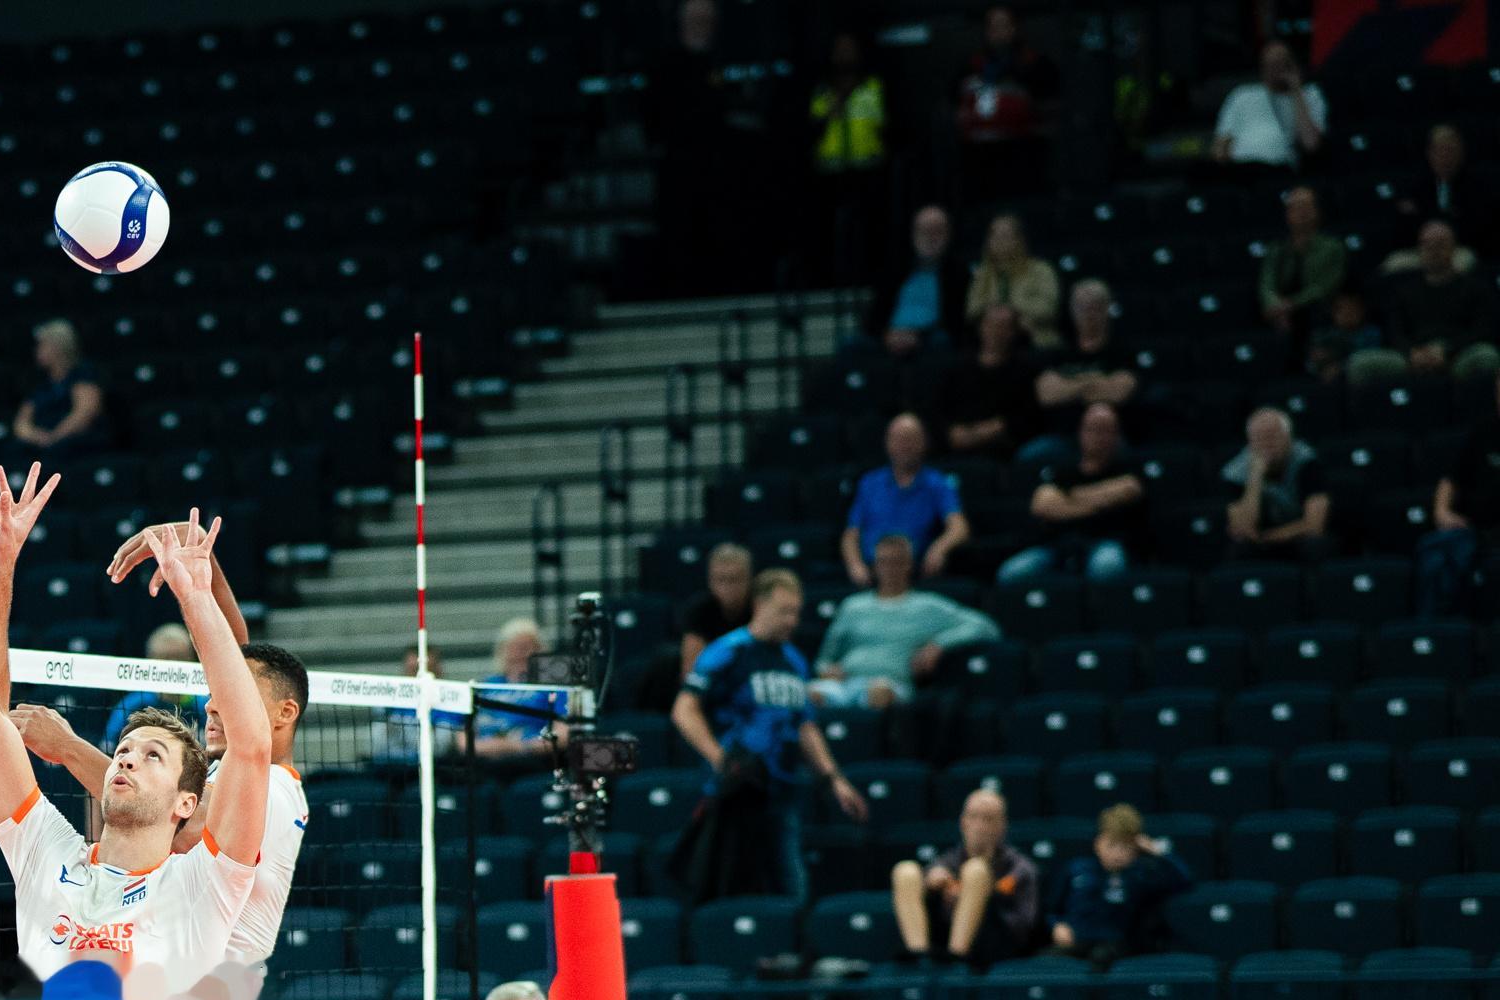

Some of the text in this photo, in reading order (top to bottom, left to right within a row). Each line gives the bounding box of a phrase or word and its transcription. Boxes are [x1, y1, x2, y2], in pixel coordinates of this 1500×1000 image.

[45, 657, 75, 681] enel
[117, 663, 134, 680] CEV
[134, 665, 151, 682] Enel
[151, 666, 190, 687] EuroVolley
[121, 890, 147, 907] NED
